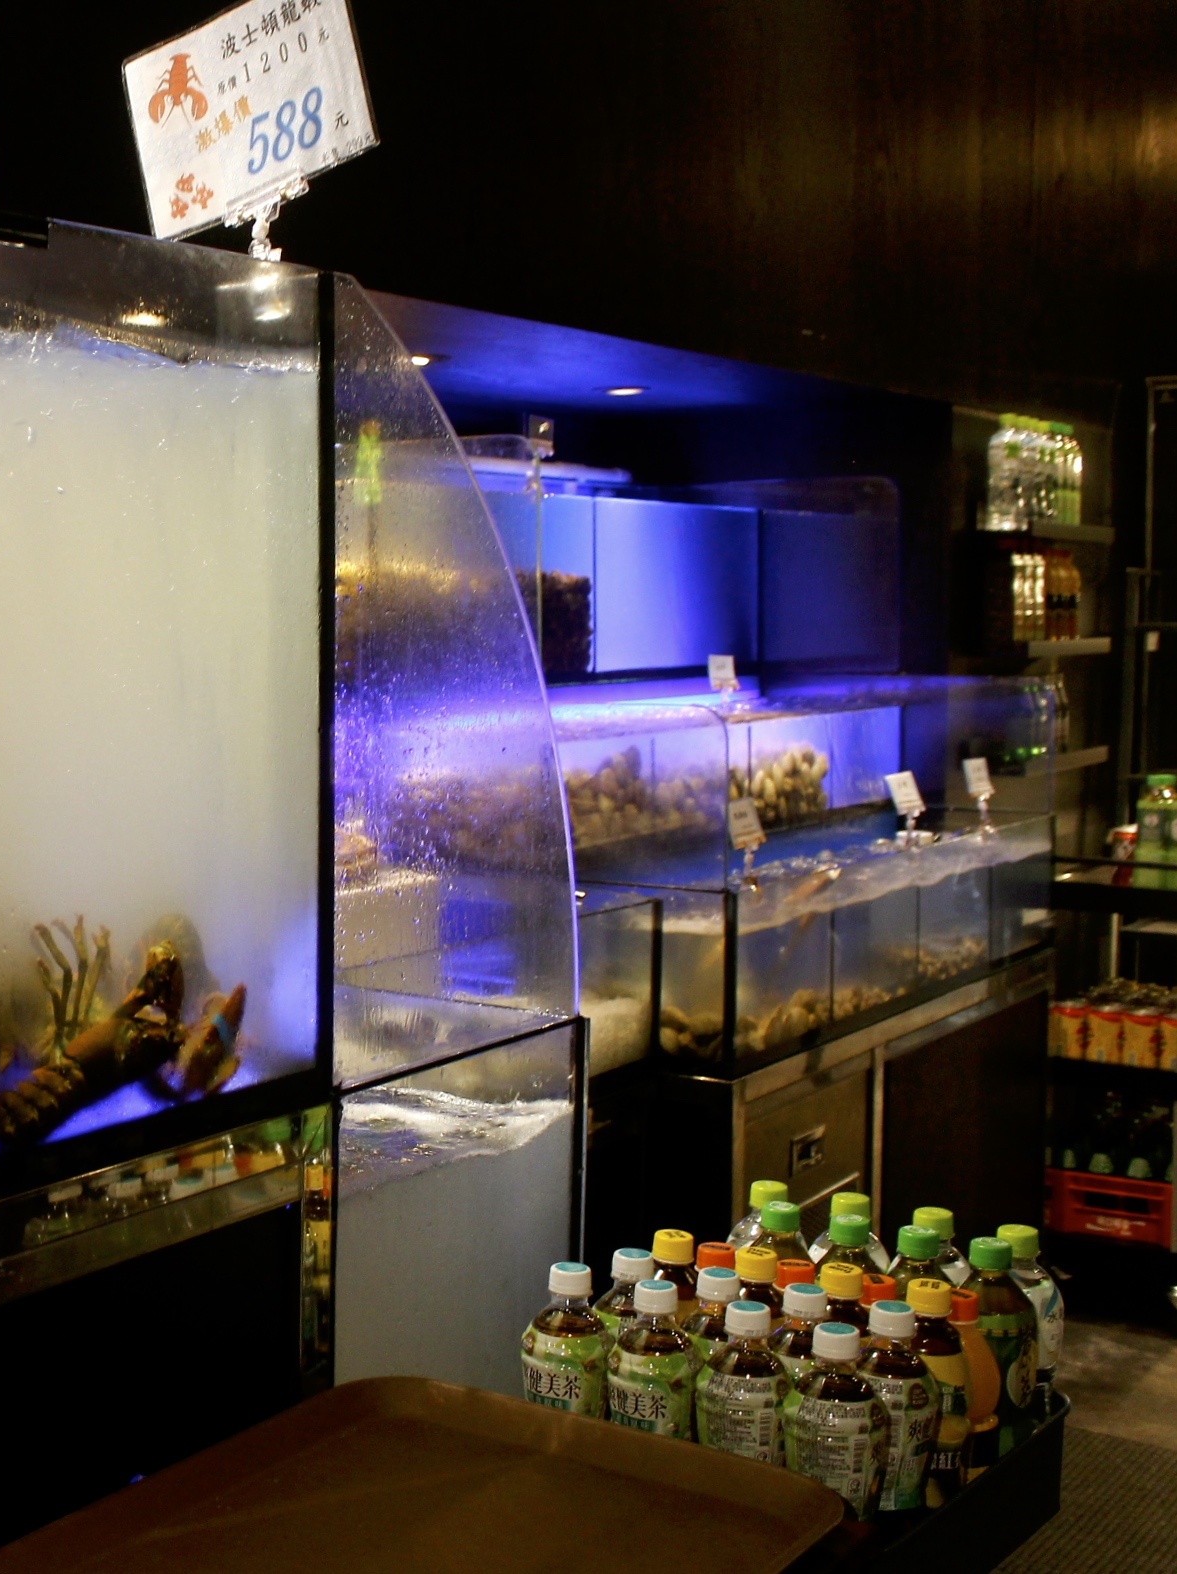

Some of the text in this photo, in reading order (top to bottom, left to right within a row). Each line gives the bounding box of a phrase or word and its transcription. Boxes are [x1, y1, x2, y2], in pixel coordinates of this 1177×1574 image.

[243, 31, 308, 83] 1200
[318, 28, 330, 43] 元
[247, 85, 323, 175] 588
[334, 110, 350, 130] 元
[524, 1367, 581, 1400] 健美茶
